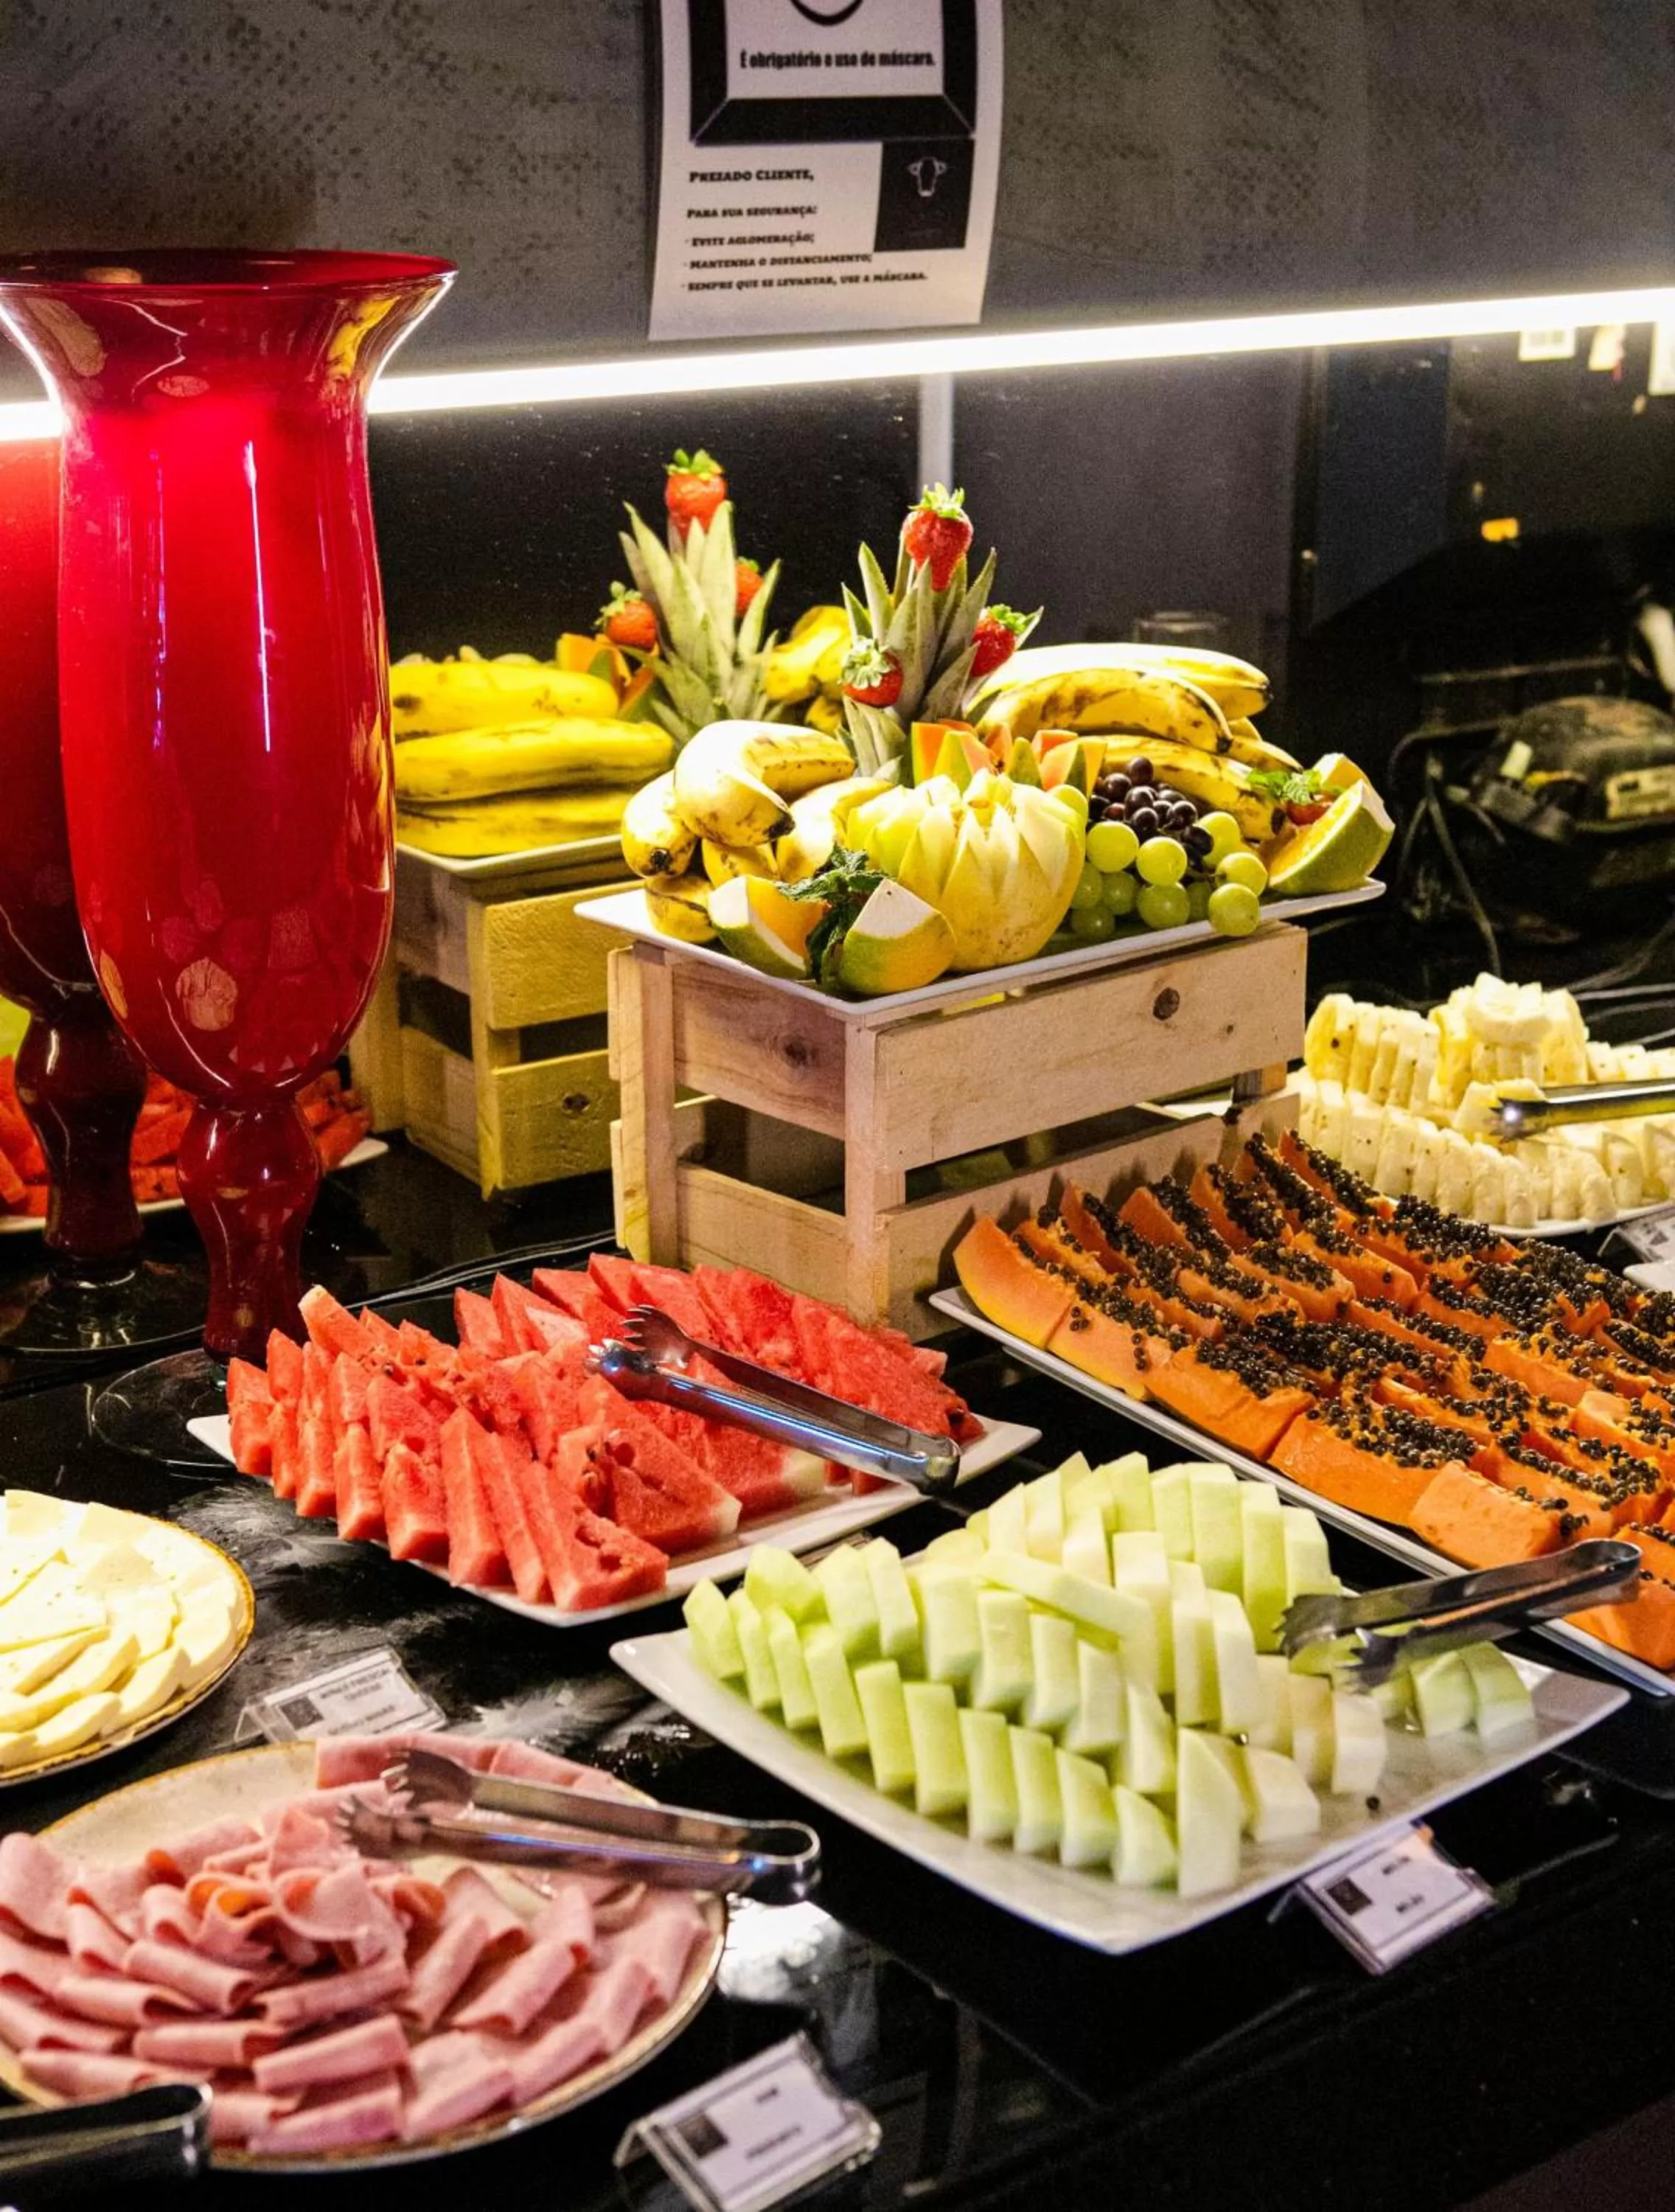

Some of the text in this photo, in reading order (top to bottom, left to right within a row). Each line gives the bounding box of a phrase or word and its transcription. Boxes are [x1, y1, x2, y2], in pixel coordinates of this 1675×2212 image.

[750, 51, 821, 70] obrigatório
[835, 53, 857, 67] uso
[861, 51, 875, 67] de
[690, 171, 752, 182] PREZADO
[687, 209, 718, 218] PARA
